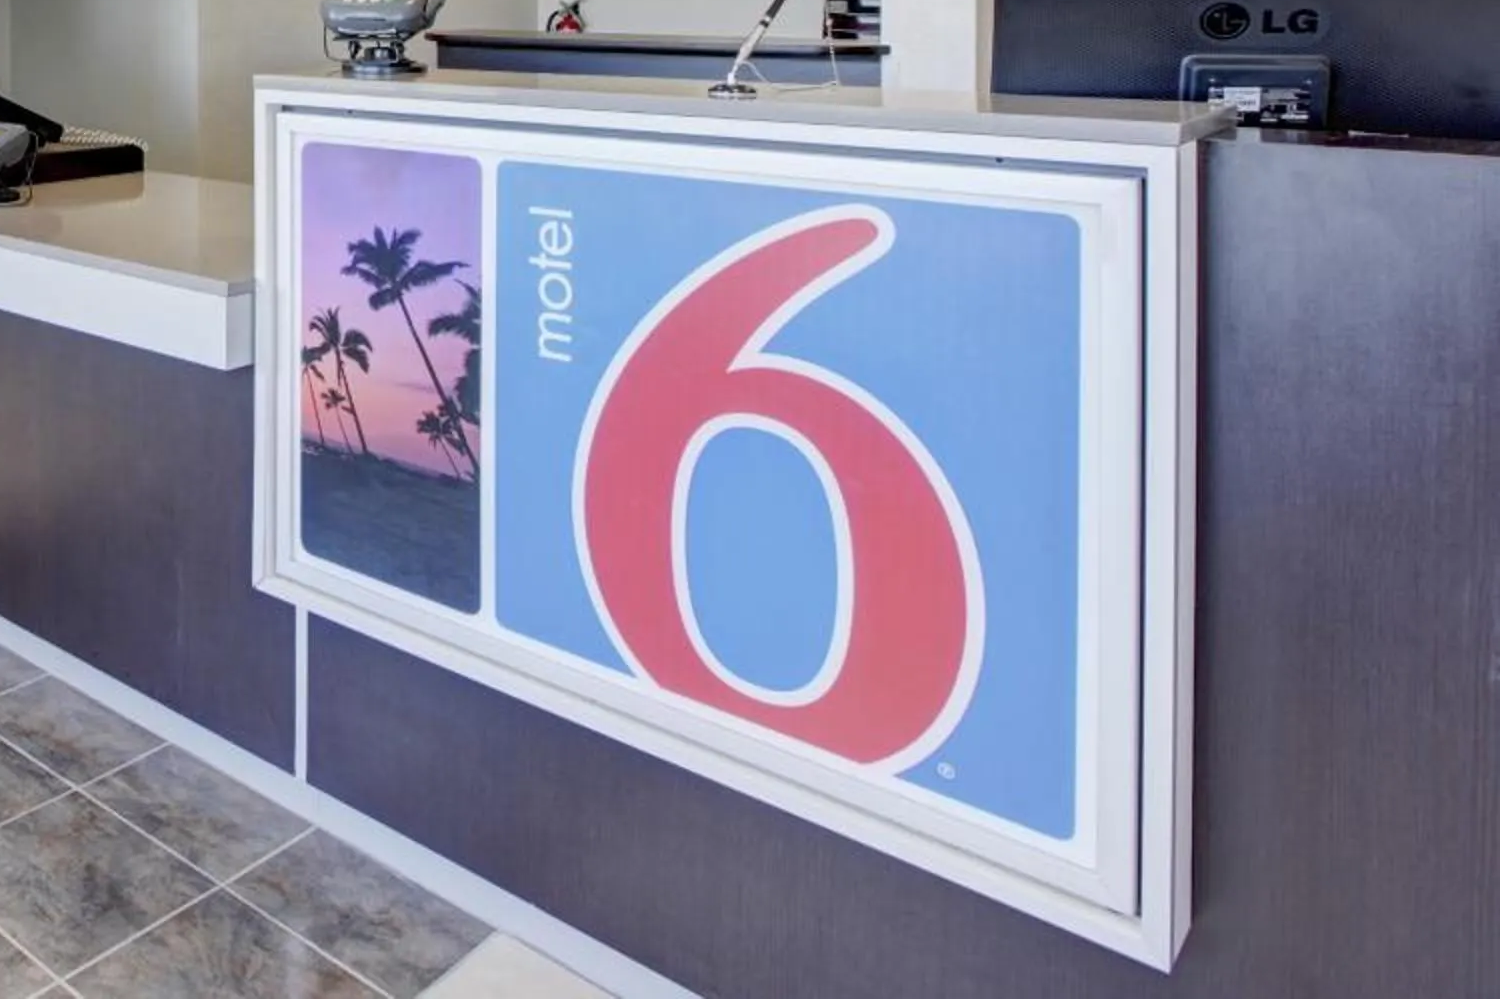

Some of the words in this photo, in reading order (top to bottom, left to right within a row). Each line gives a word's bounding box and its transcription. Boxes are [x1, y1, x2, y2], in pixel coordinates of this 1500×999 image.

[1261, 8, 1319, 34] LG
[528, 205, 574, 363] motel
[572, 203, 986, 777] 6
